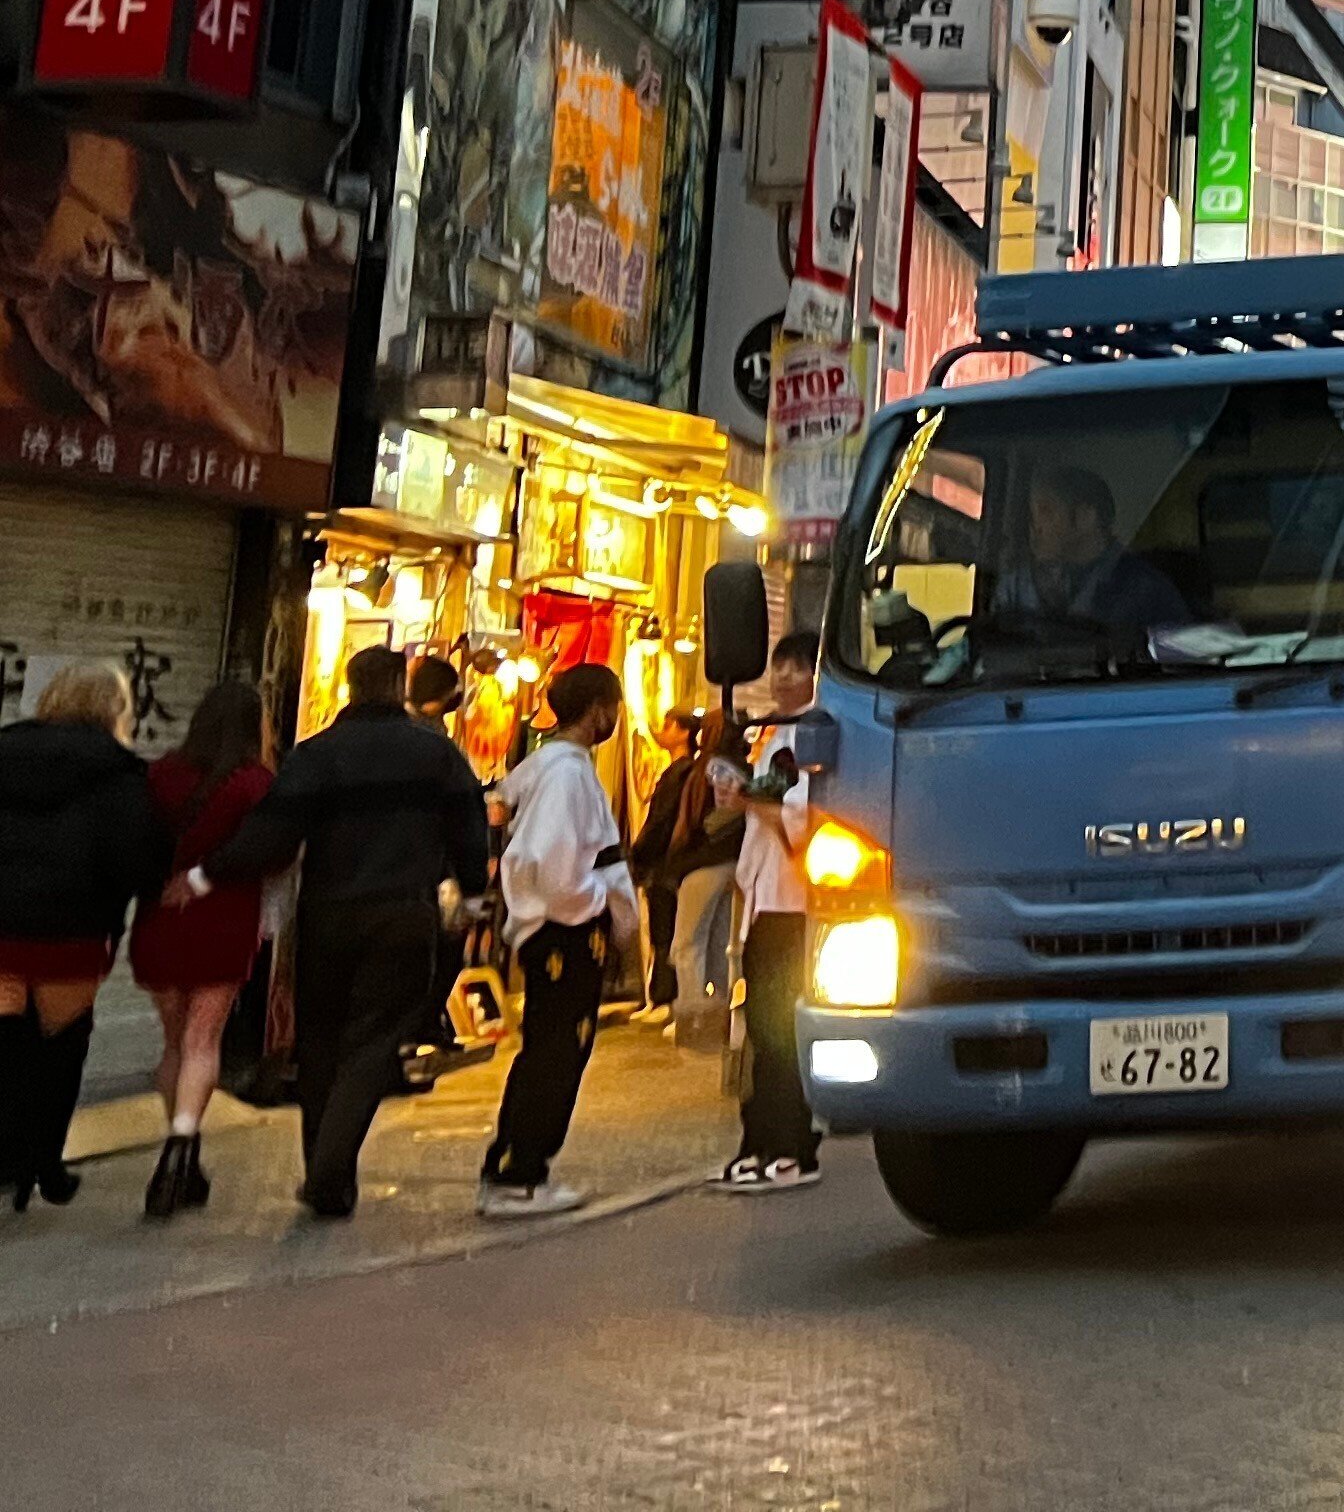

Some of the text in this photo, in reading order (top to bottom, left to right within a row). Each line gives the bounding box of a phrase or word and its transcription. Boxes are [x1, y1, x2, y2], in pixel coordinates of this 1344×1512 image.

[775, 367, 845, 409] STOP
[1085, 816, 1246, 857] ISUZU
[1120, 1044, 1221, 1086] 67-82
